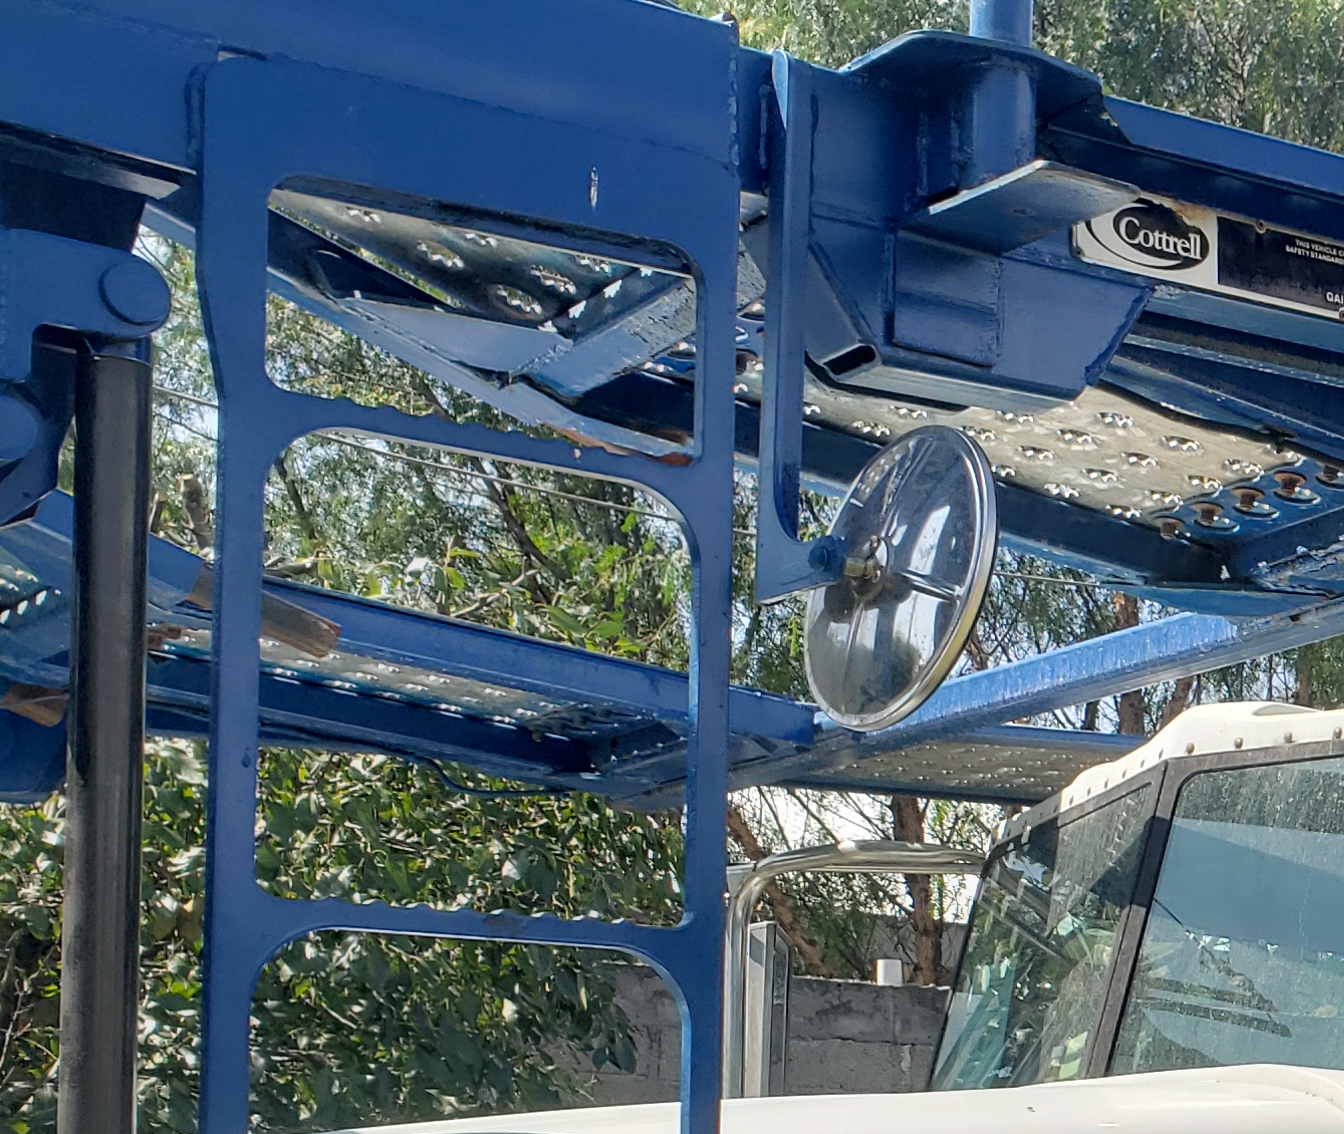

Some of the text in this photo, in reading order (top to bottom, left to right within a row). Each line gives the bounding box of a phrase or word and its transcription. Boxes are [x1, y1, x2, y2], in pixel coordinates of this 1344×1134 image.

[1120, 217, 1203, 260] Cottrell
[1285, 244, 1310, 257] SAFETY
[1295, 239, 1310, 249] THIS
[1311, 243, 1337, 255] VEHICLE
